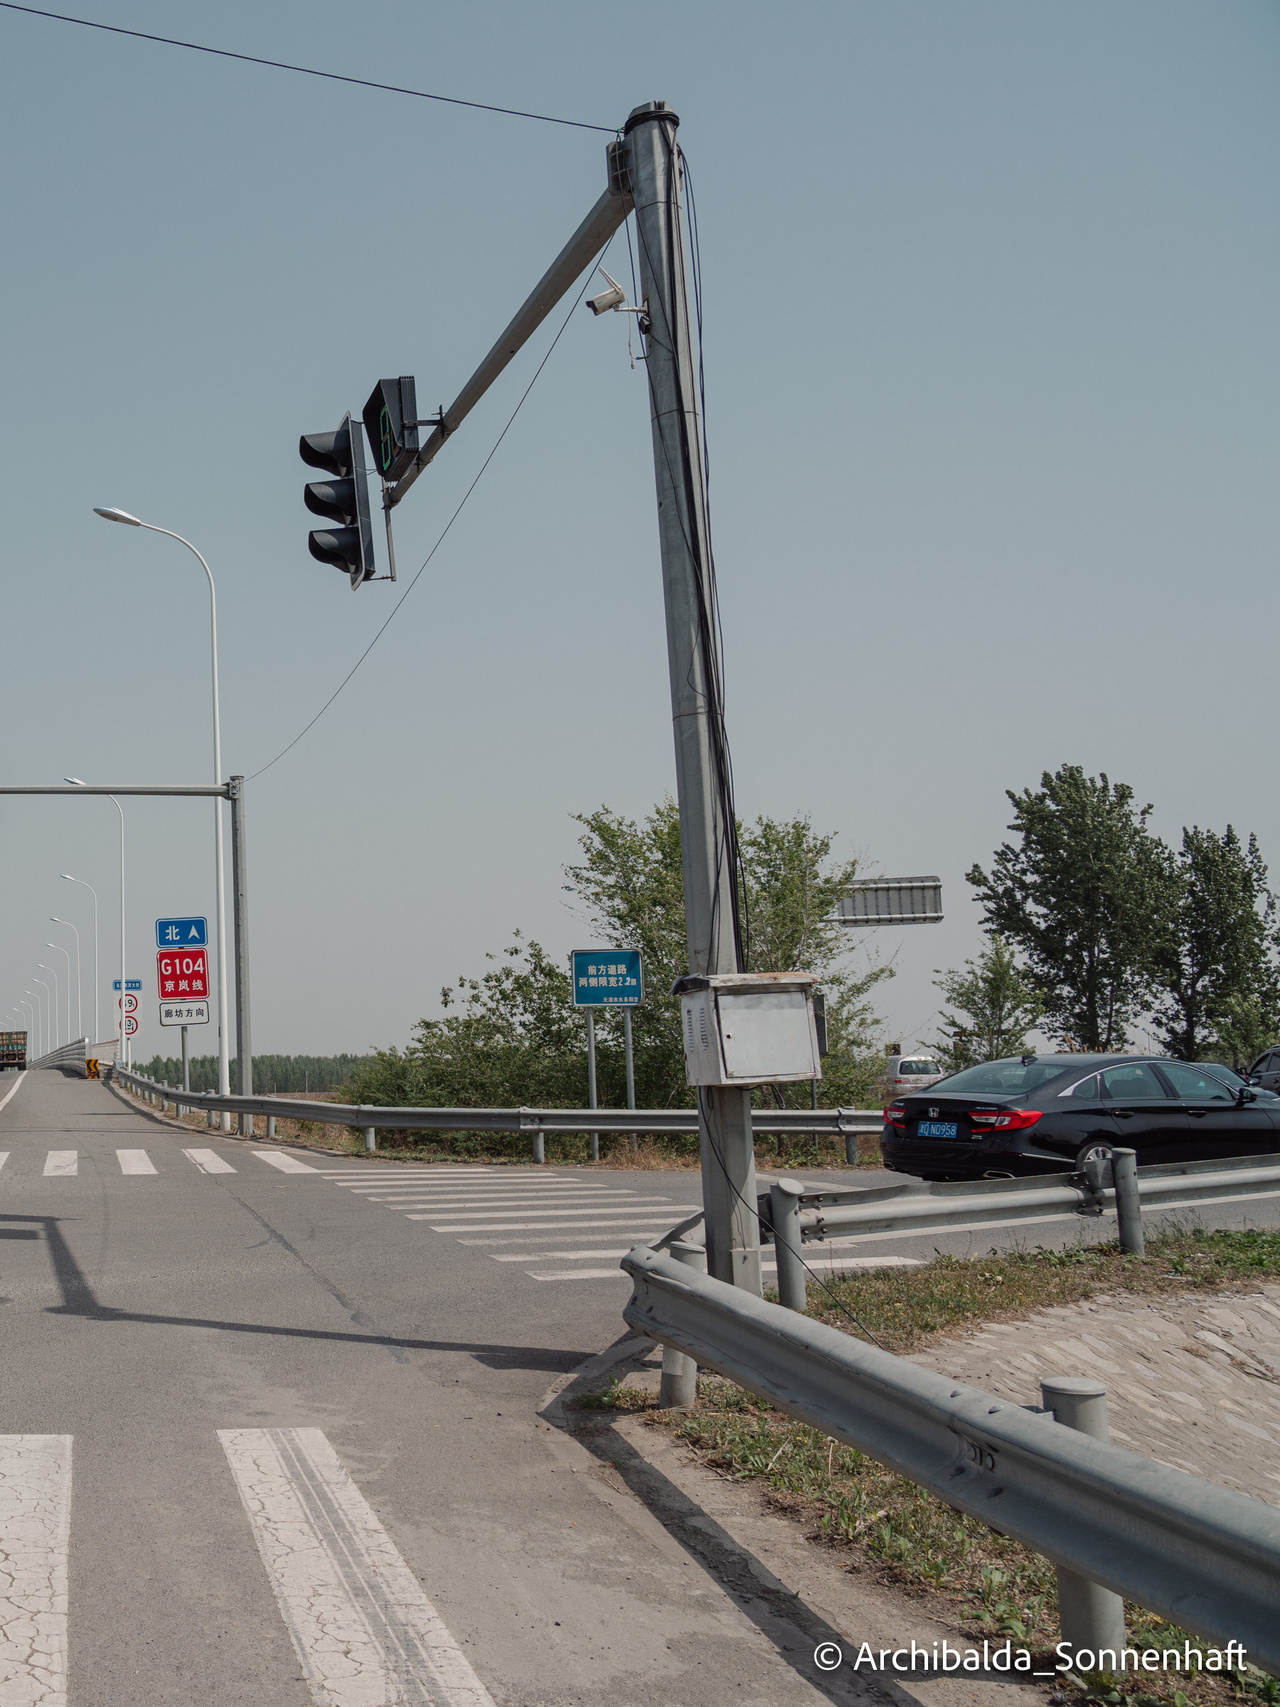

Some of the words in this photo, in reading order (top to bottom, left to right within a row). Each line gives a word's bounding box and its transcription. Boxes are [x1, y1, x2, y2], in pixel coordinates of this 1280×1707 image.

[165, 925, 180, 941] 北
[161, 958, 204, 975] G104
[588, 964, 627, 975] 前方道路
[164, 979, 204, 992] 京岚线
[164, 1008, 204, 1019] 廊坊方向
